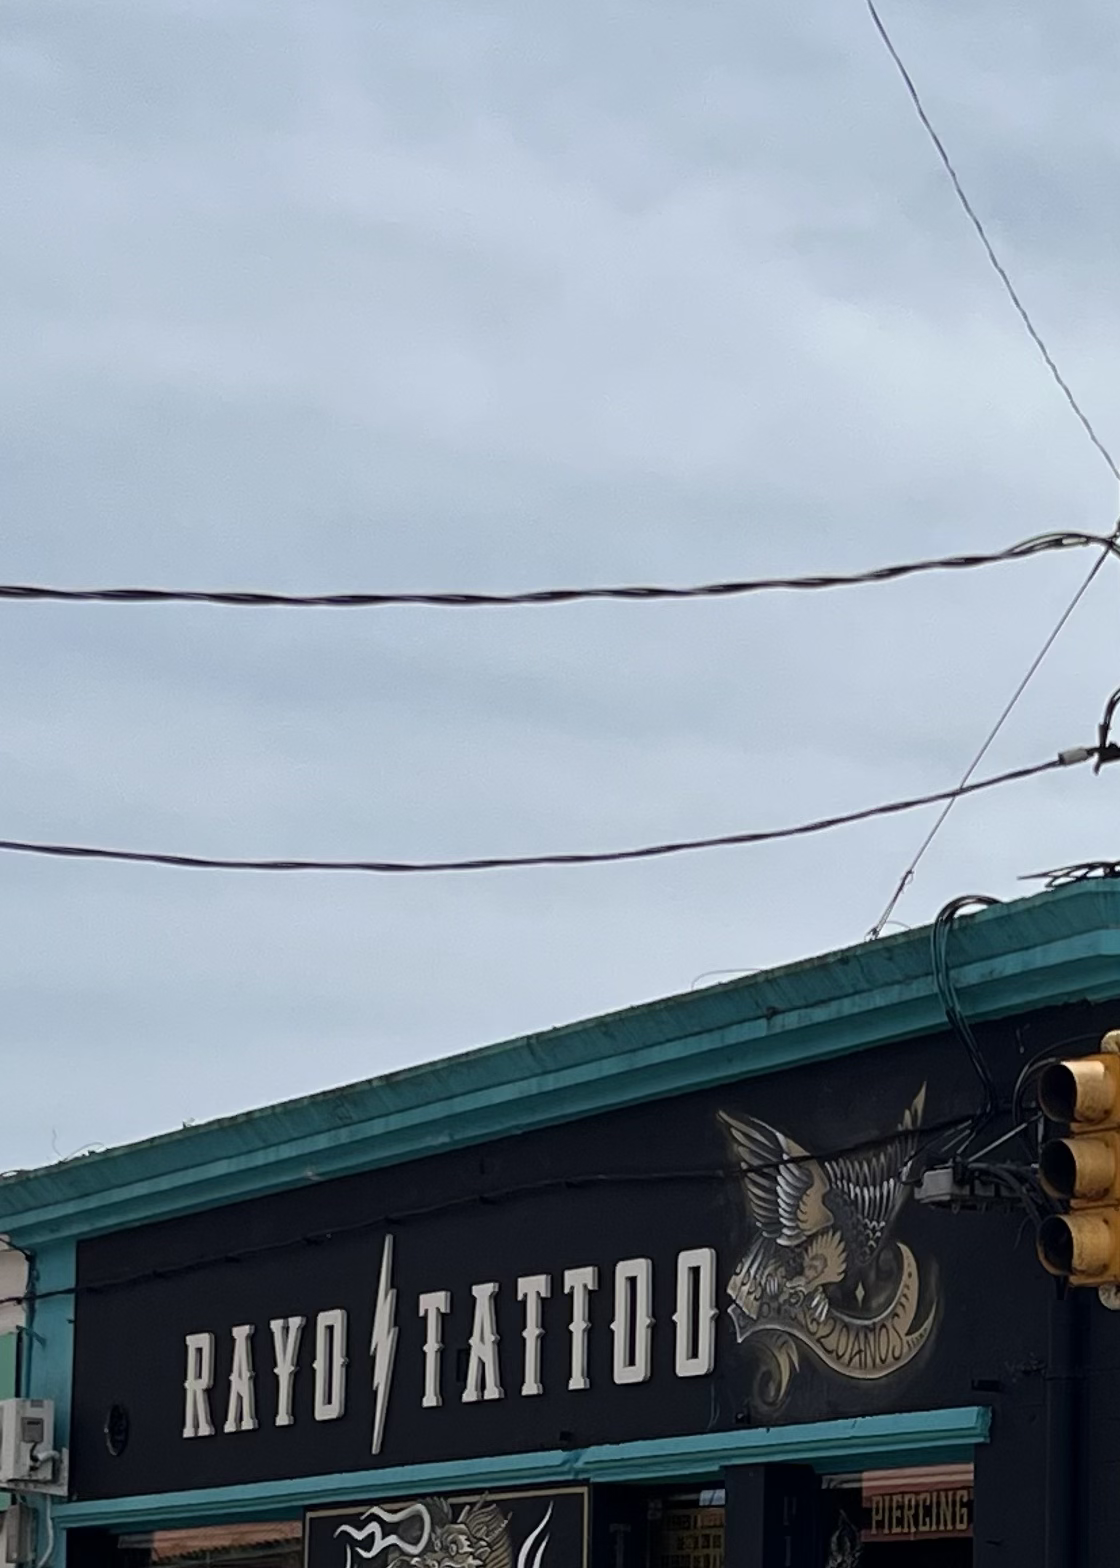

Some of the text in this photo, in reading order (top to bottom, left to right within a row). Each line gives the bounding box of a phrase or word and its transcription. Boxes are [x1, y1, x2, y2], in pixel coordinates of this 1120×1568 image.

[182, 1246, 719, 1438] RAYO TATTOO
[870, 1489, 969, 1534] PIERCING
